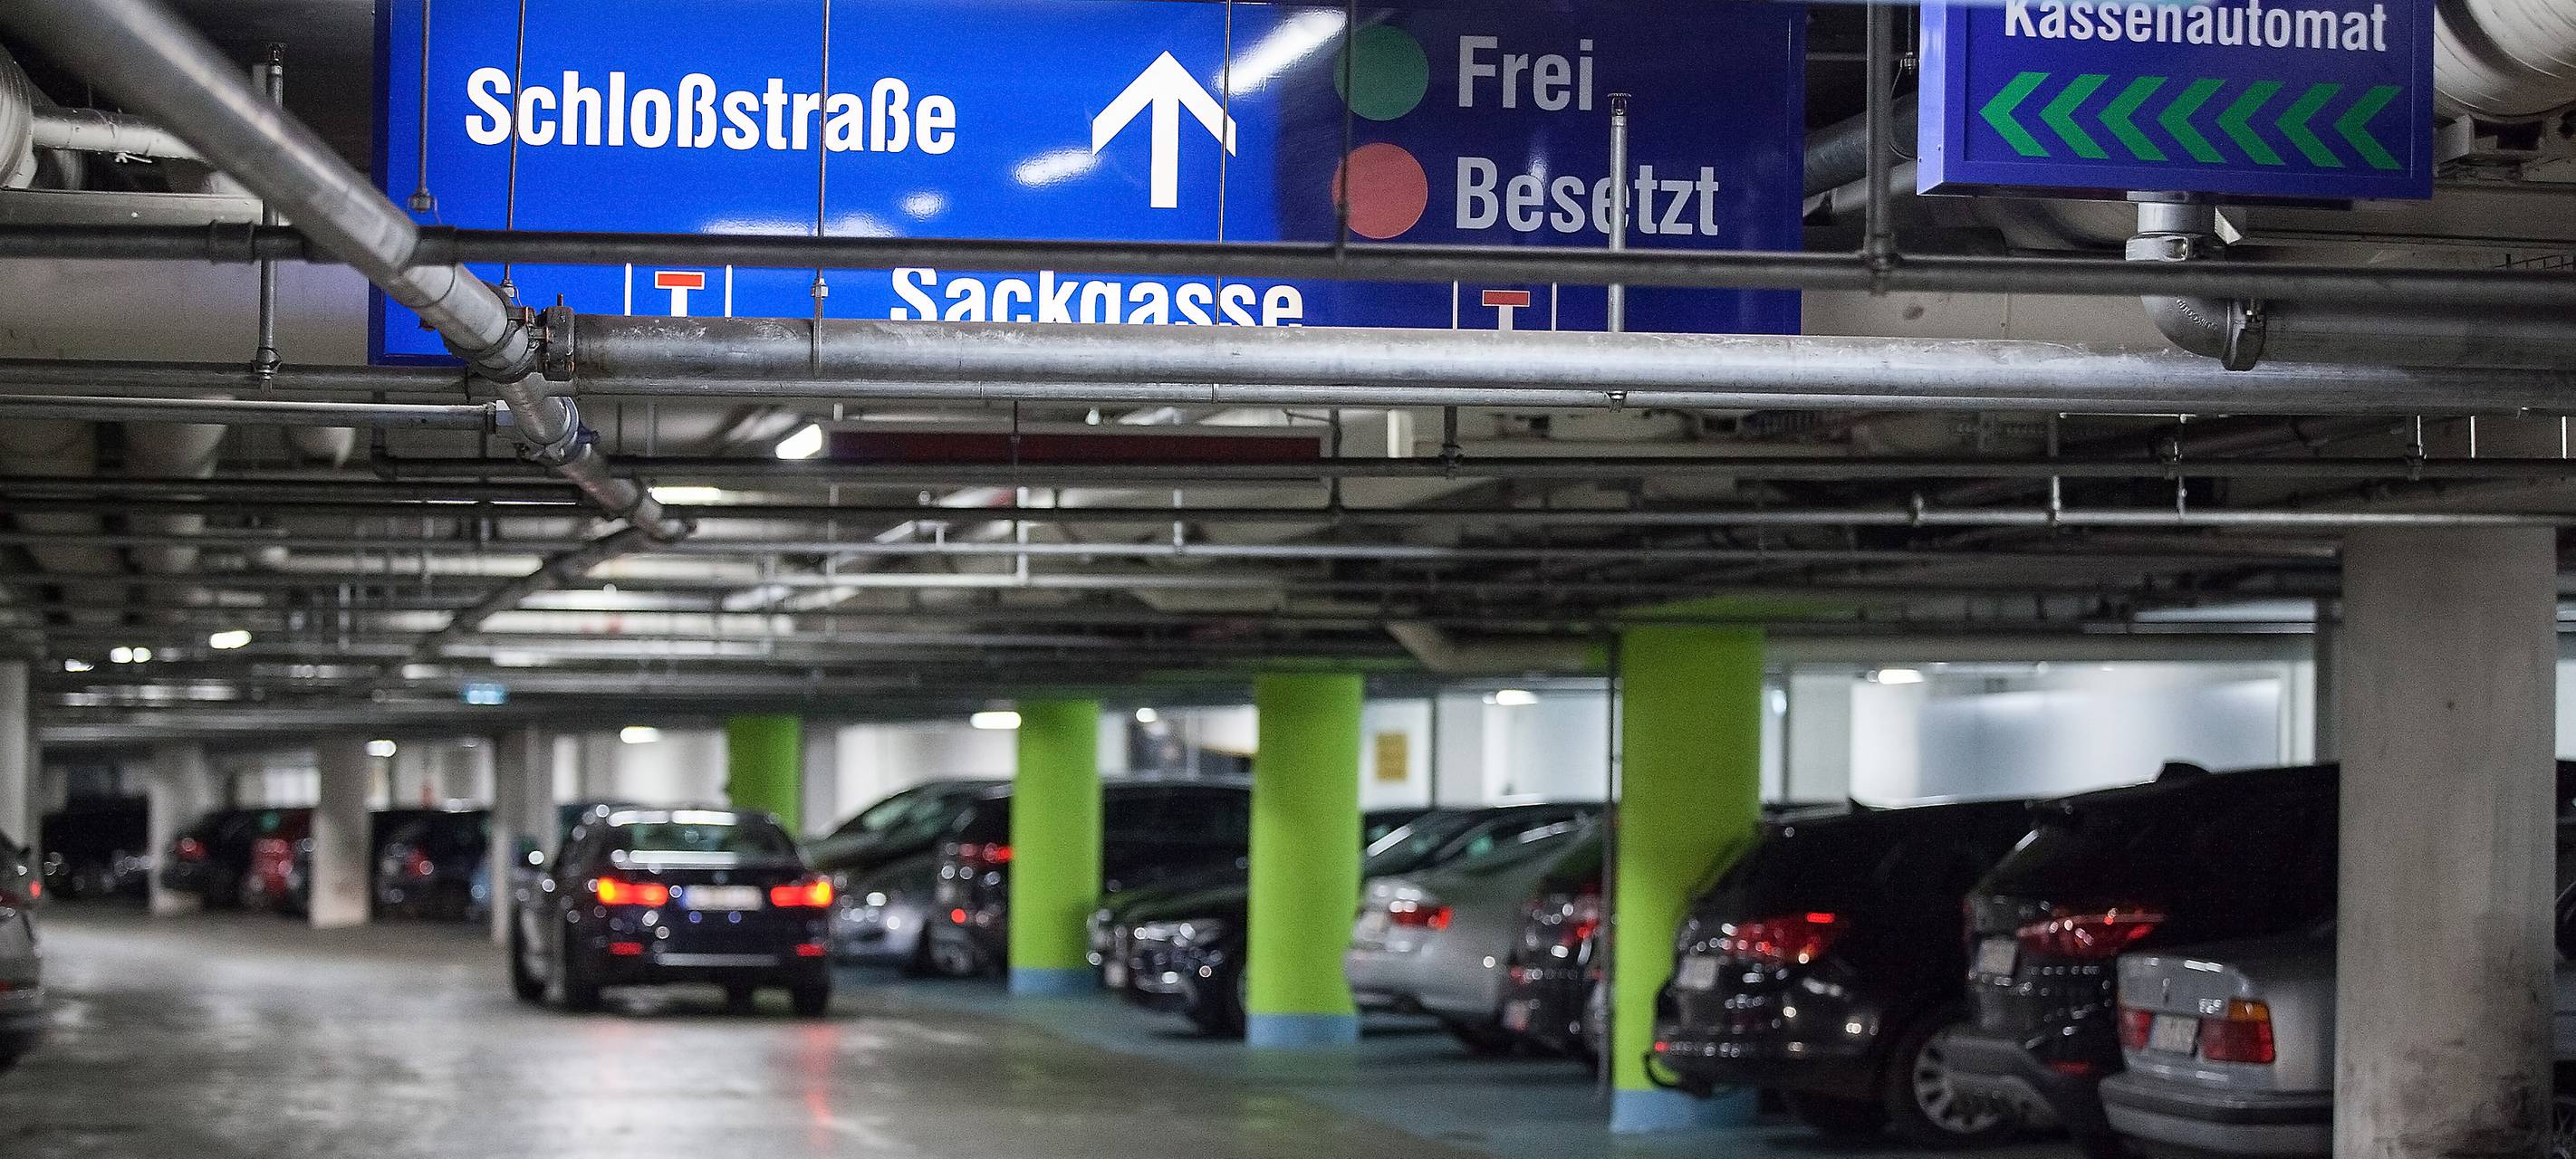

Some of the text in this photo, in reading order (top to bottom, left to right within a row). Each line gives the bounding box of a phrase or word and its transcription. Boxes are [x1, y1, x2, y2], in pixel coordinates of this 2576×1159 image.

[2004, 0, 2388, 52] Kassenautomat
[464, 66, 957, 155] Schloßstraße
[1457, 34, 1594, 111] Frei
[1456, 156, 1719, 236] Besetzt
[889, 266, 1304, 328] Sackgasse
